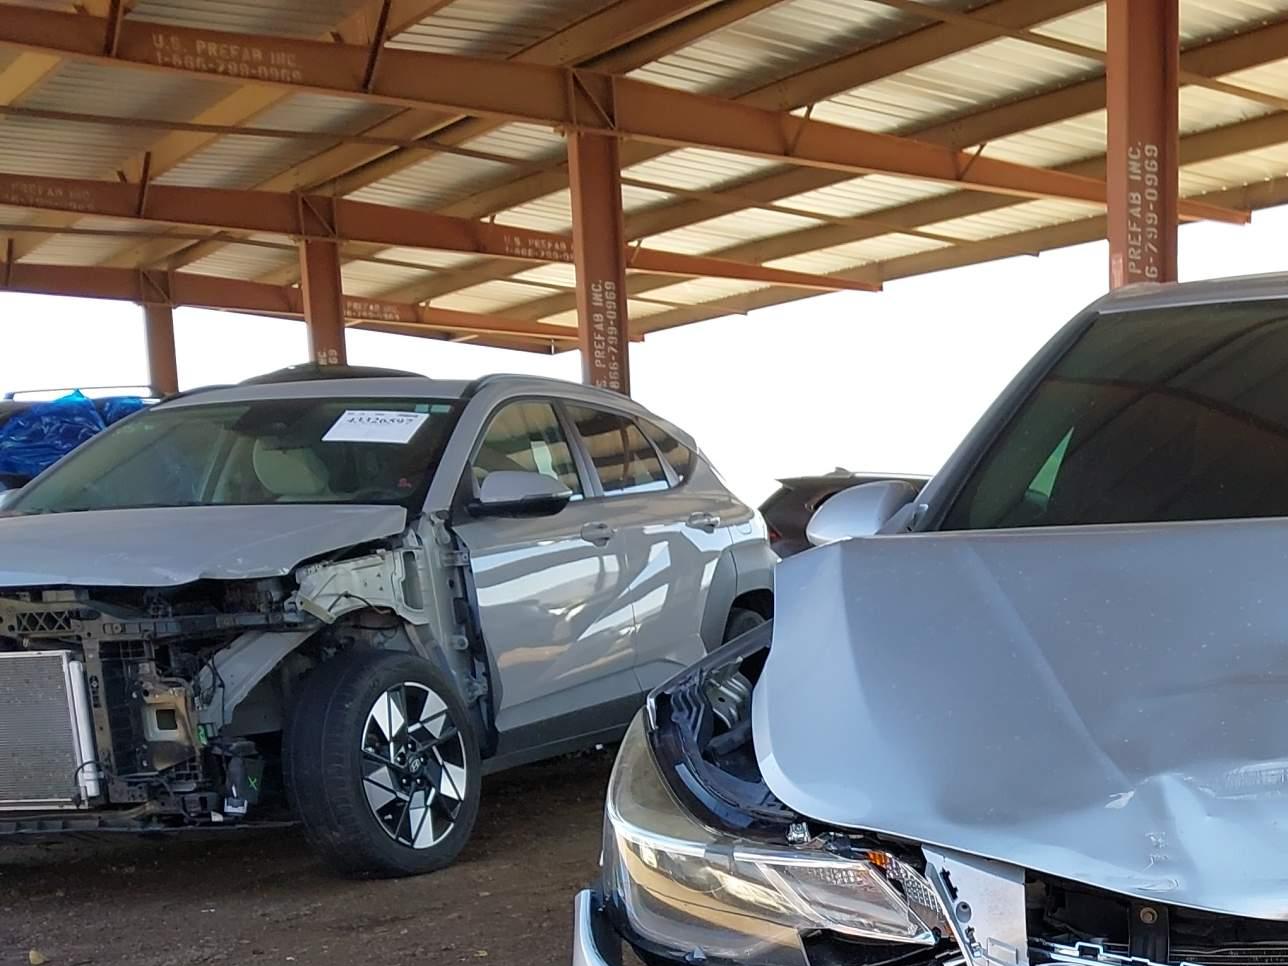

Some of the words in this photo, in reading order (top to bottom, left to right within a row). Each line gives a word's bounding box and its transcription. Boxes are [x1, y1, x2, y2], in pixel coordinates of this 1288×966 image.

[1128, 140, 1142, 181] INC.
[1127, 192, 1142, 274] PREFAB
[591, 279, 604, 306] INC.
[593, 313, 607, 369] PREFAB
